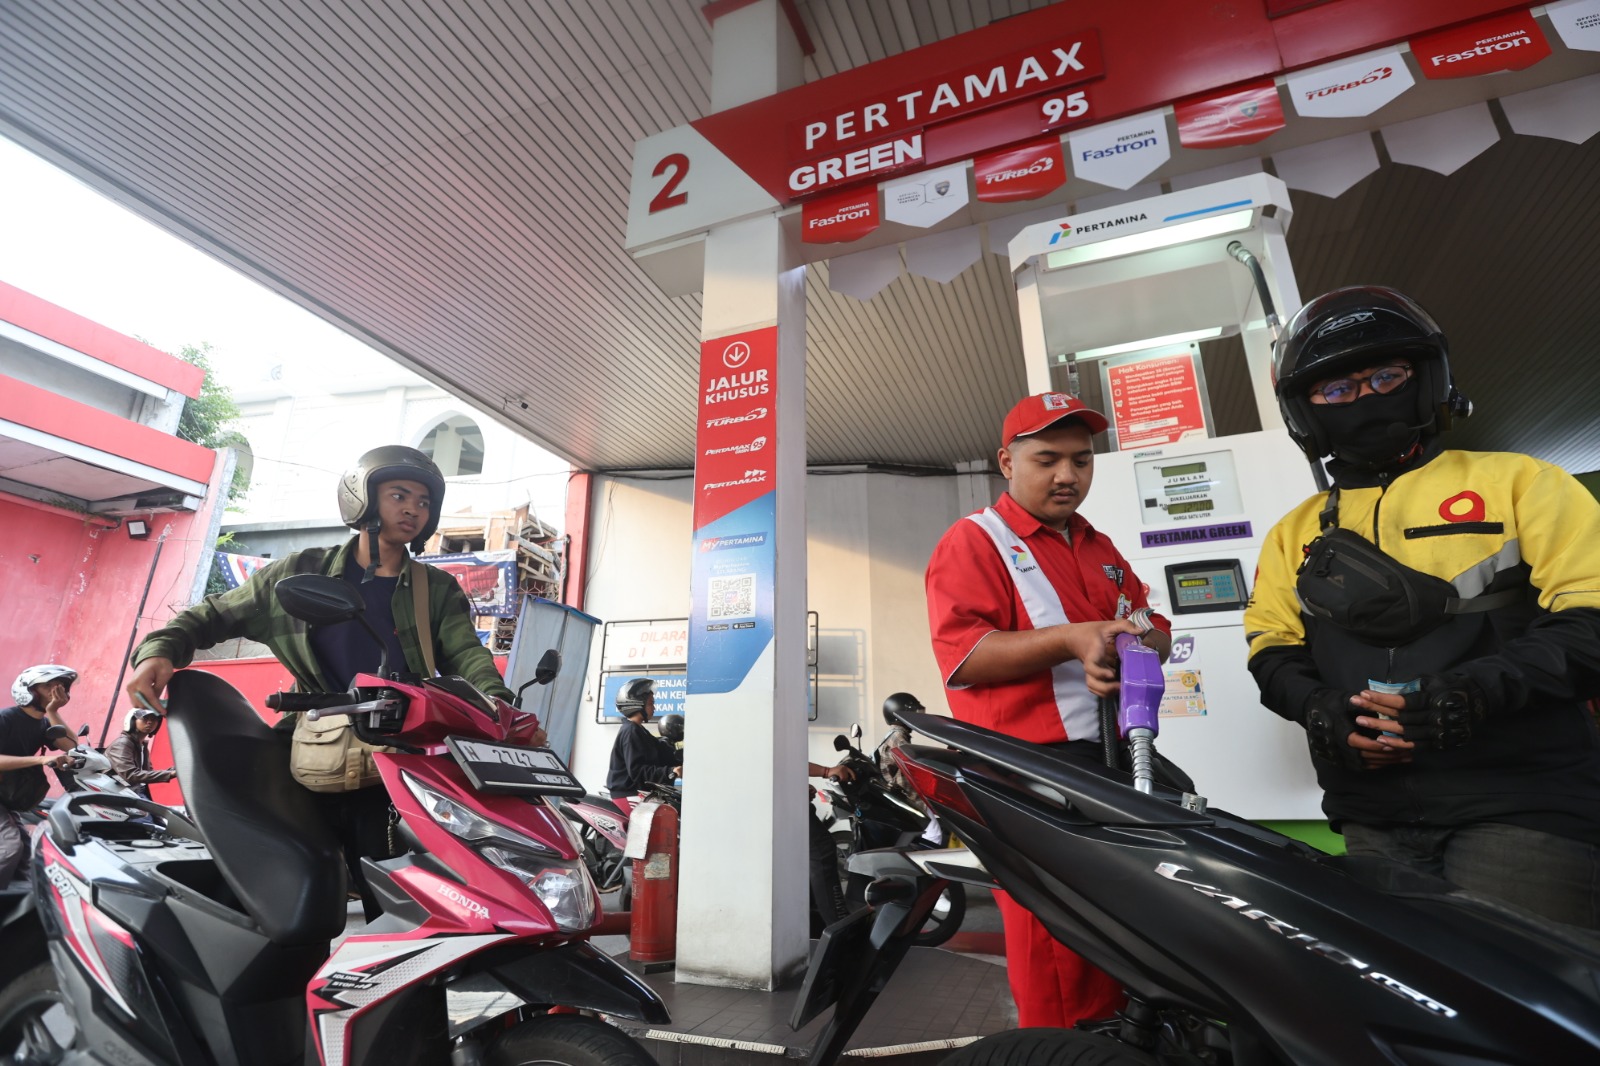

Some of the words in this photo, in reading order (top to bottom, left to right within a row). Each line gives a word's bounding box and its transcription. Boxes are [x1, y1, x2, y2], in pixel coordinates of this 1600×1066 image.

[1476, 30, 1526, 45] PERTAMINA
[1431, 36, 1532, 66] Fastron
[804, 41, 1085, 151] PERTAMAX
[1306, 76, 1379, 101] TURBO
[1042, 92, 1089, 124] 95
[1117, 129, 1155, 142] PERTAMINA
[1082, 137, 1158, 162] Fastron
[788, 134, 923, 192] GREEN
[648, 152, 690, 216] 2
[985, 166, 1042, 184] TURBO
[838, 202, 870, 214] PERTAMINA
[809, 208, 870, 229] Fastron
[1076, 213, 1148, 234] PERTAMINA
[1118, 366, 1134, 374] Hak
[706, 369, 768, 393] JALUR
[705, 384, 769, 405] KHUSUS
[706, 414, 758, 428] TURBO
[705, 444, 750, 456] PERTAMAX
[753, 440, 764, 448] 95
[704, 476, 766, 490] PERTAMAX
[1168, 475, 1204, 483] JUMLAH
[1170, 494, 1207, 502] DIKELUARKAN
[1146, 528, 1207, 544] PERTAMAX
[1209, 525, 1247, 538] GREEN
[1172, 642, 1192, 659] 95
[436, 884, 490, 919] HONDA
